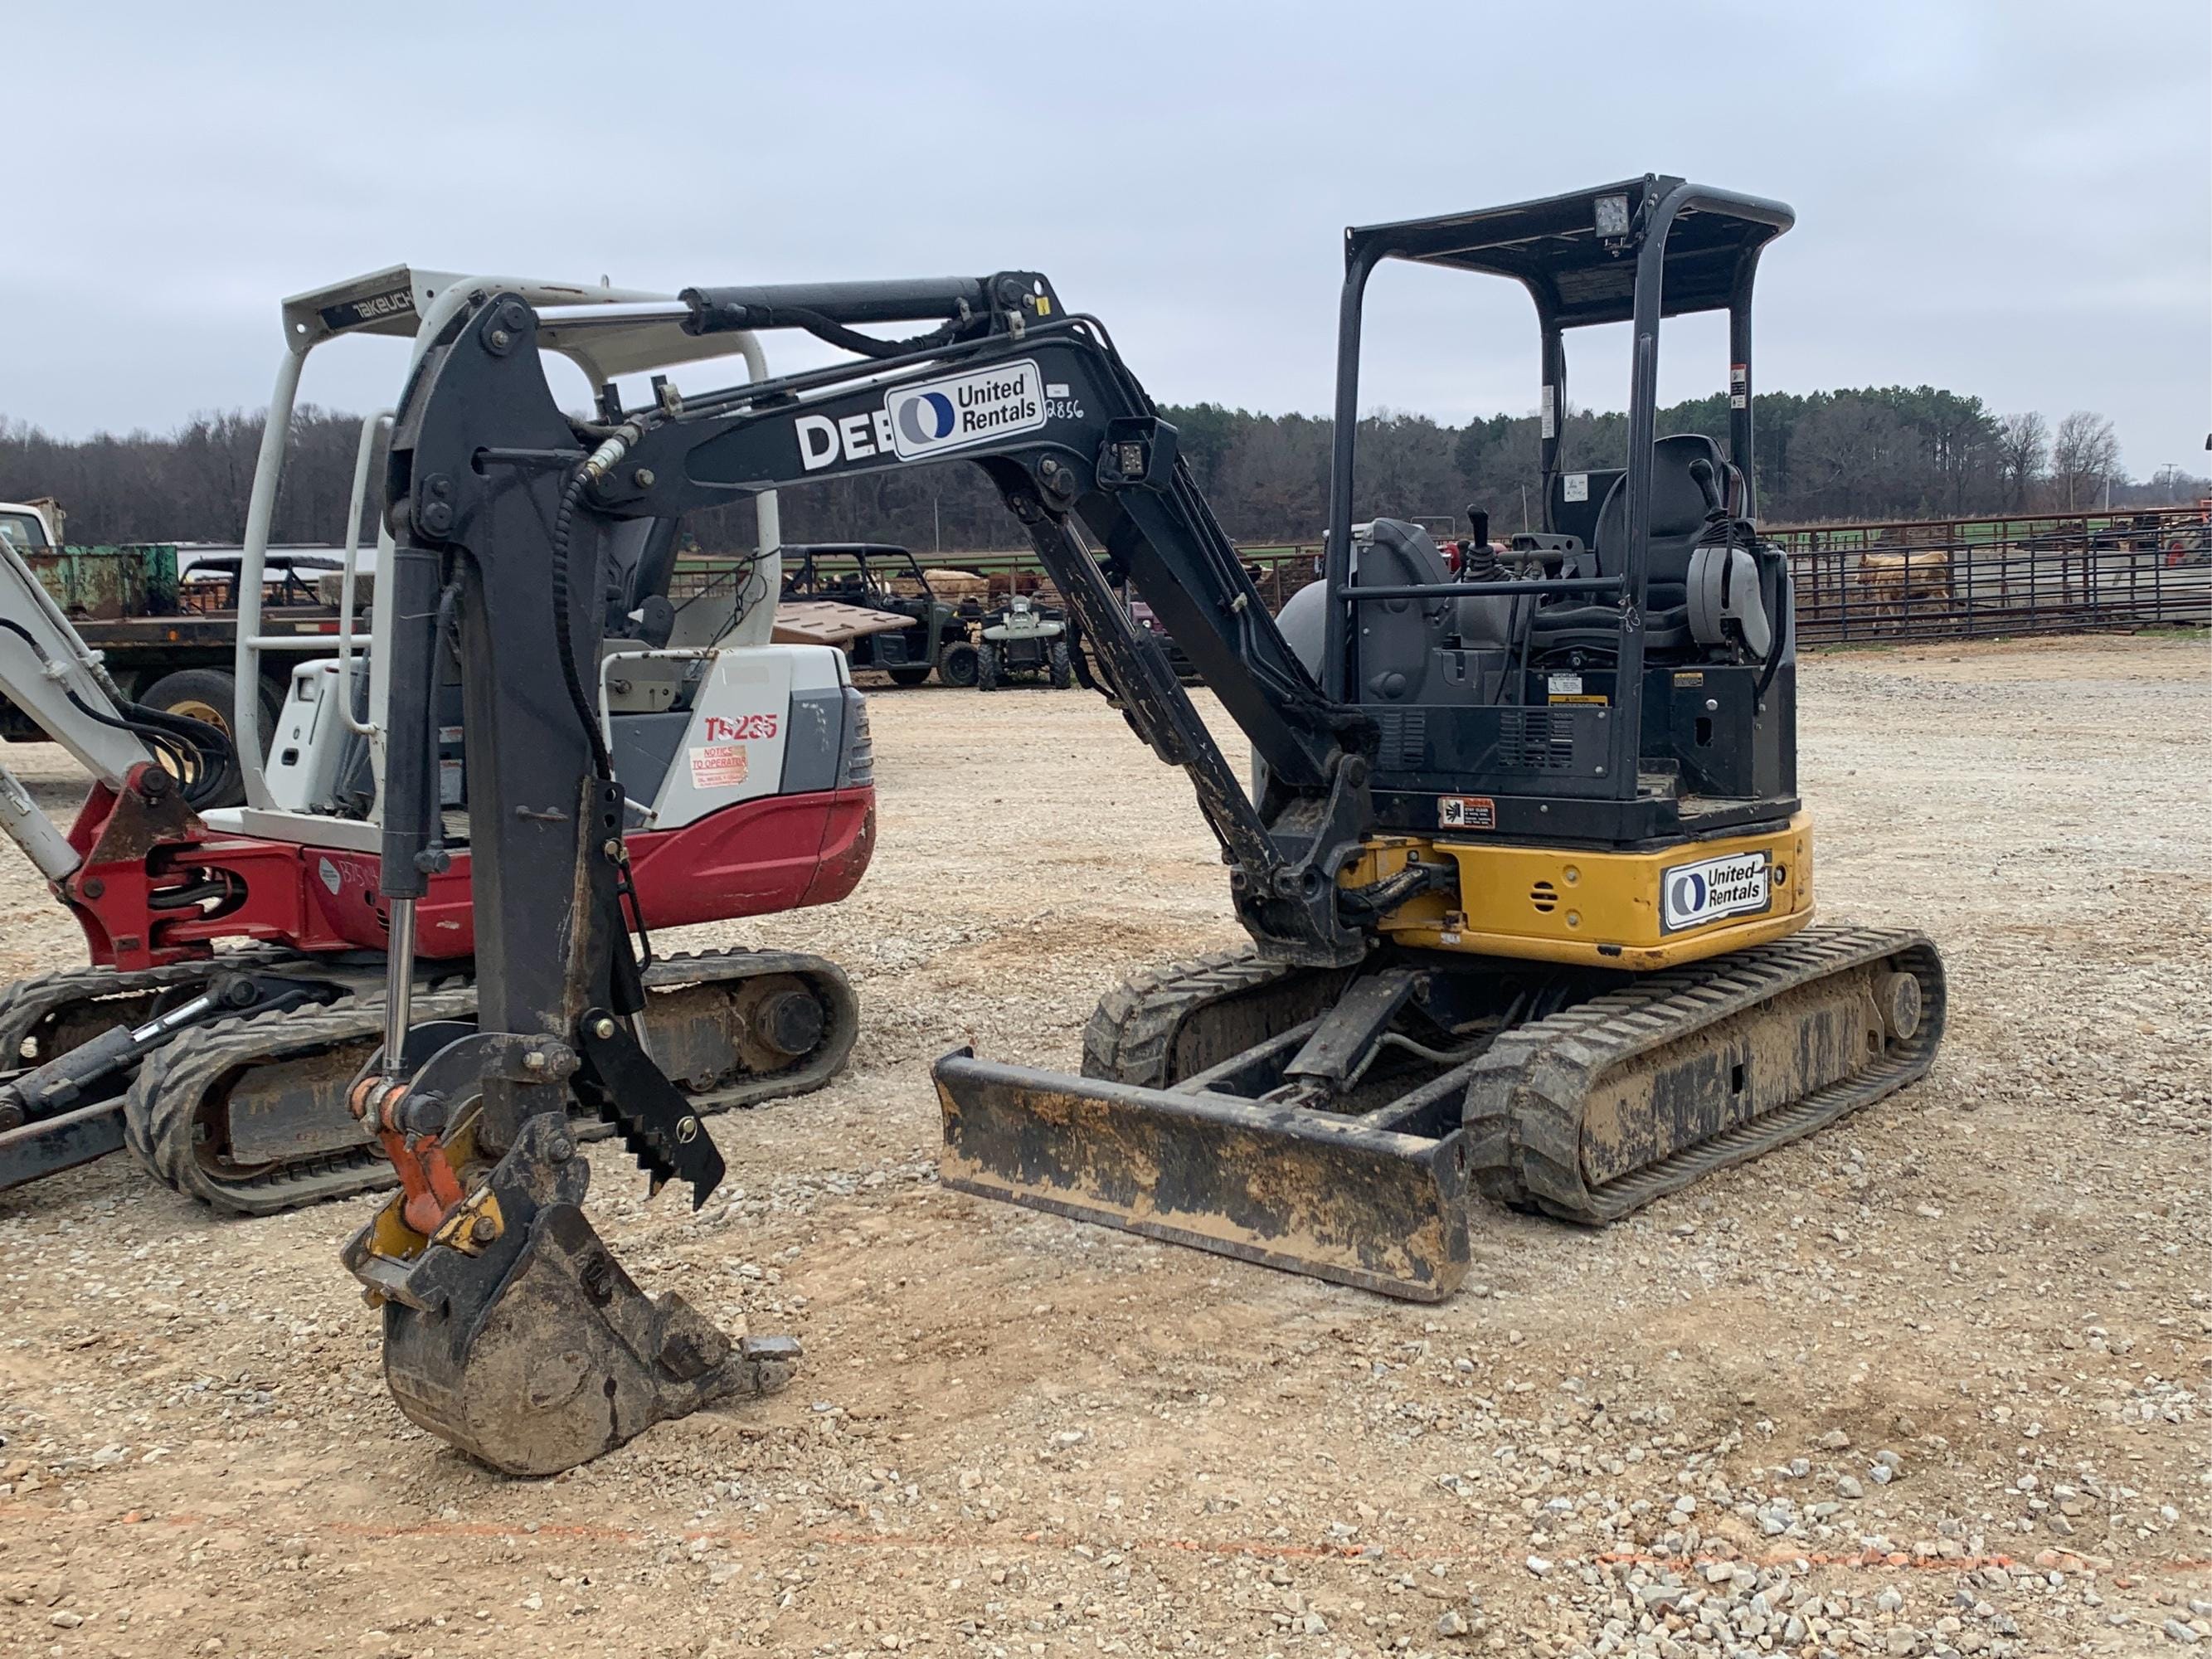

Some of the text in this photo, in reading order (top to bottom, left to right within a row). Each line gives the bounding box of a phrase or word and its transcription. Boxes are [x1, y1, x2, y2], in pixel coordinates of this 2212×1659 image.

[958, 373, 1024, 408] United
[963, 398, 1036, 433] Rentals
[1045, 399, 1084, 419] 2856
[693, 757, 746, 769] TO OPERATOR
[1709, 861, 1755, 888] United
[1709, 881, 1760, 907] Rentals
